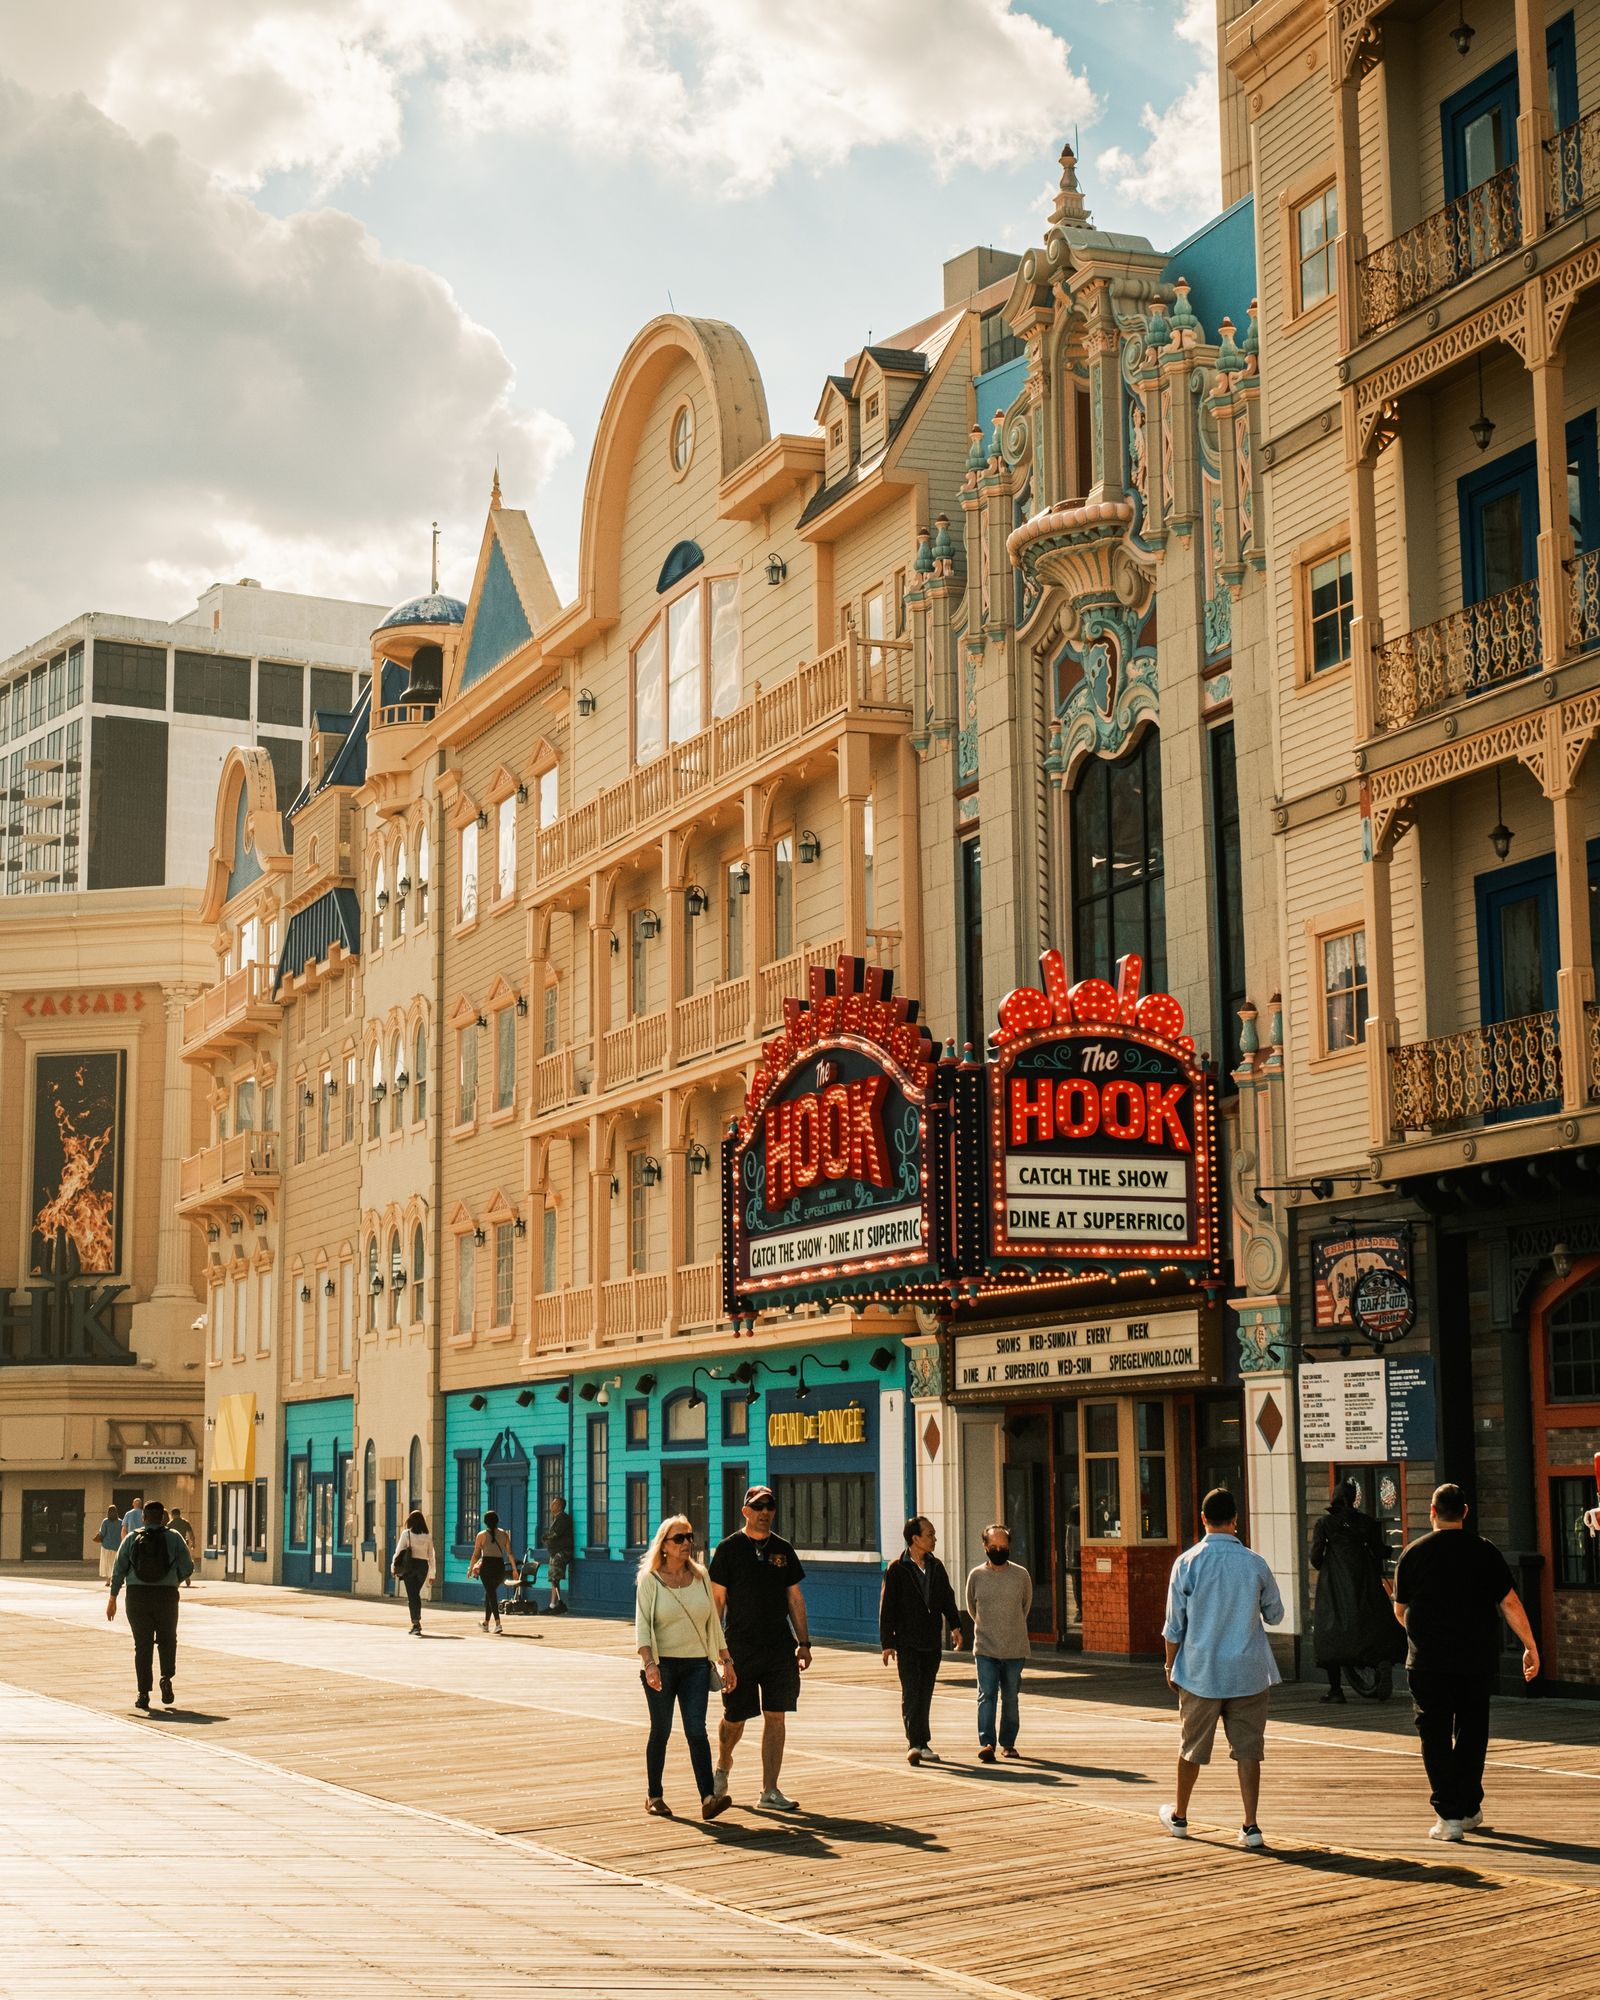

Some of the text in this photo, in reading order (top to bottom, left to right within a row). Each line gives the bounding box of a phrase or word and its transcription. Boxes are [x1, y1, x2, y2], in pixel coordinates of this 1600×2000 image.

[22, 991, 146, 1017] CAESARS
[815, 1058, 832, 1089] The
[1081, 1044, 1120, 1073] The
[1009, 1077, 1192, 1153] HOOK
[765, 1075, 890, 1213] HOOK
[1019, 1167, 1169, 1188] CATCH THE SHOW
[1009, 1210, 1185, 1232] DINE AT SUPERFRICO
[752, 1243, 777, 1268] CATCH
[778, 1241, 795, 1263] THE
[797, 1235, 823, 1260] SHOW
[829, 1231, 850, 1255] DINE
[853, 1229, 864, 1251] AT
[1345, 1238, 1372, 1251] RAL
[1372, 1237, 1399, 1249] DEAL
[996, 1322, 1150, 1354] SHOWS WED-SUNDAY EVERY WEEK
[963, 1347, 1193, 1384] DINE AT SUPERFRICO WED-SUN SPIEGELWORLD.COM
[768, 1400, 862, 1447] CHEVAL DE PLONGÉE
[133, 1456, 188, 1465] BEACHSIDE
